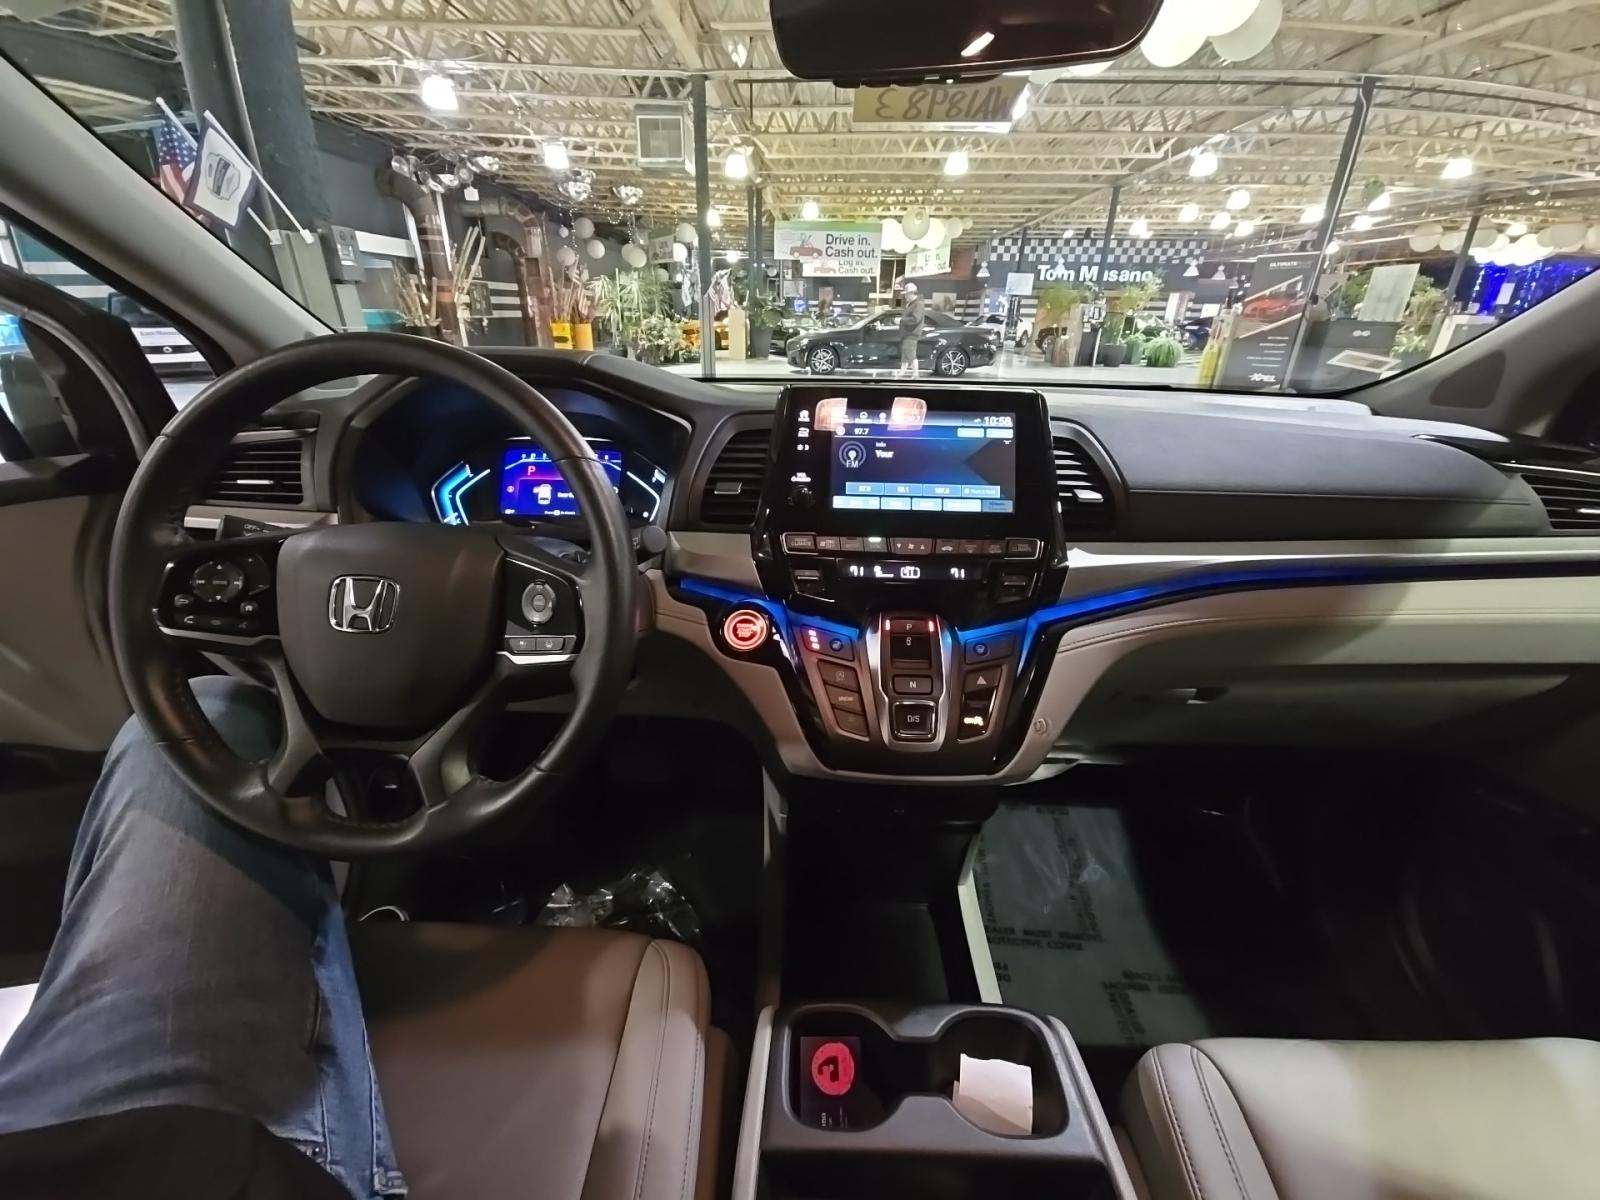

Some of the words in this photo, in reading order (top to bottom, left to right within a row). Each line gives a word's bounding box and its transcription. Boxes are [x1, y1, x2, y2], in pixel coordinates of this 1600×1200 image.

[826, 233, 856, 246] Drive
[858, 234, 871, 246] in.
[825, 246, 854, 258] Cash
[857, 248, 878, 259] out.
[838, 266, 858, 274] Cash
[1037, 264, 1075, 281] Tom
[875, 450, 894, 458] Your
[846, 460, 859, 468] FM
[527, 465, 536, 476] P
[906, 623, 913, 631] P
[909, 680, 917, 689] N
[907, 714, 920, 723] D/S
